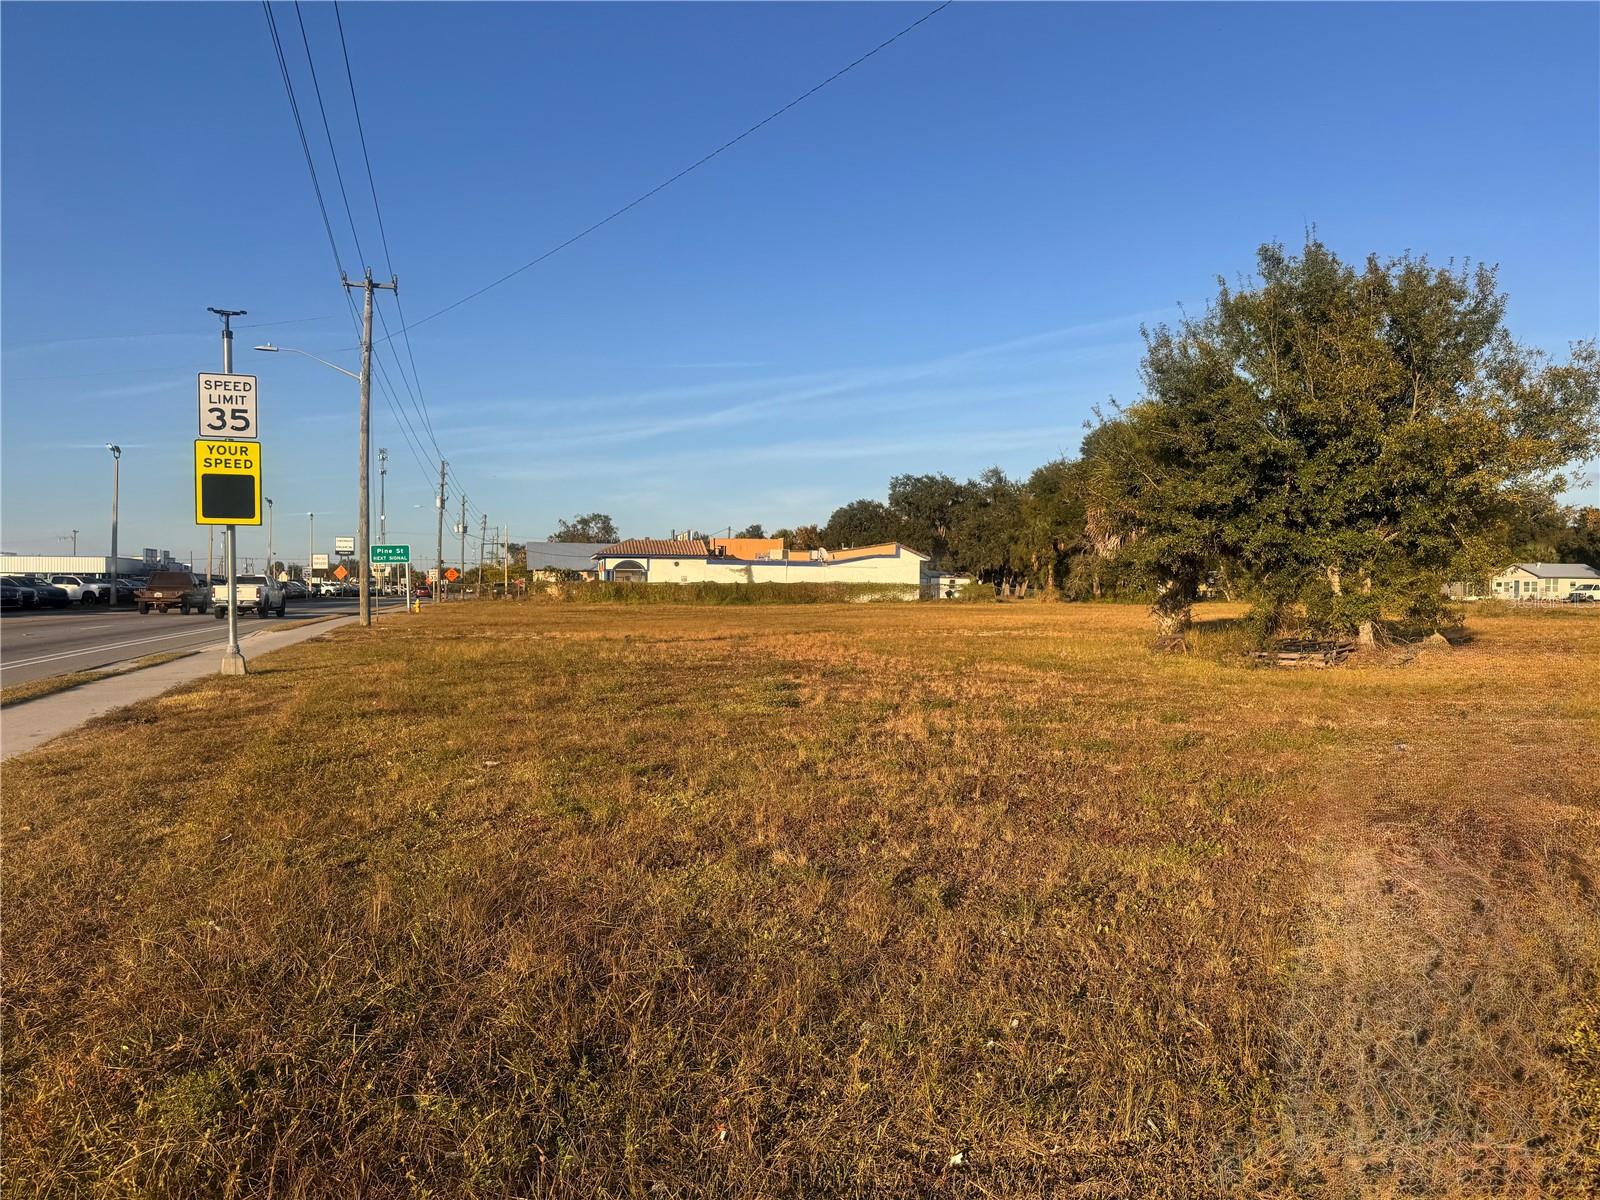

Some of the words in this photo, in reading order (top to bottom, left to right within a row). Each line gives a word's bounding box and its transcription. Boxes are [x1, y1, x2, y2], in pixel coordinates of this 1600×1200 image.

[203, 379, 252, 392] SPEED
[208, 394, 247, 405] LIMIT
[207, 407, 250, 431] 35
[206, 444, 249, 456] YOUR
[203, 457, 253, 469] SPEED
